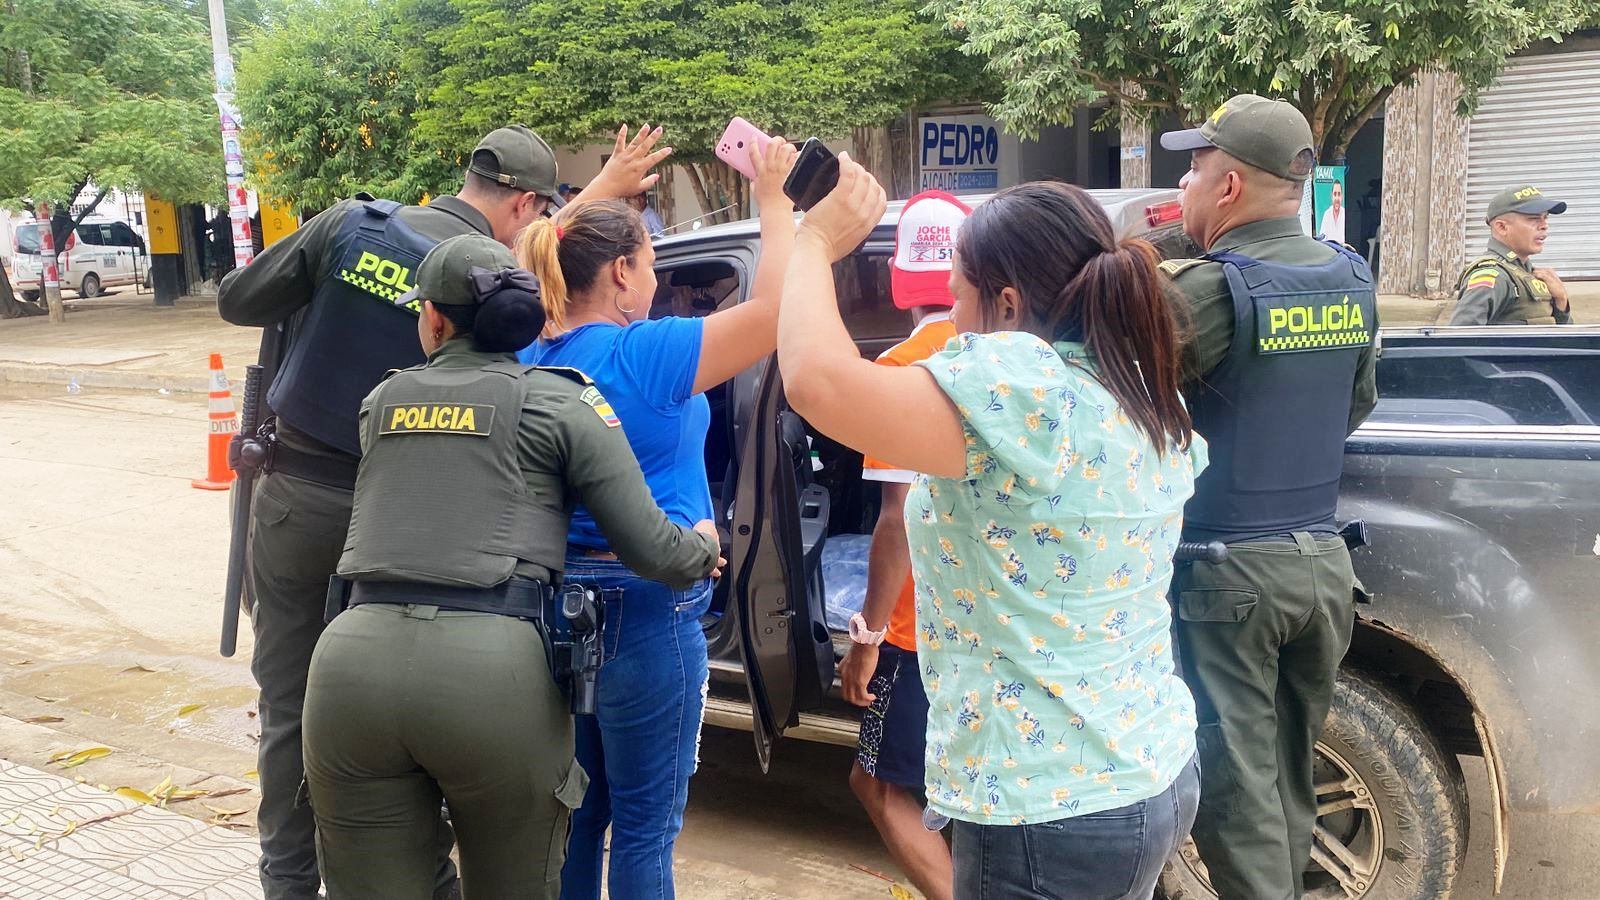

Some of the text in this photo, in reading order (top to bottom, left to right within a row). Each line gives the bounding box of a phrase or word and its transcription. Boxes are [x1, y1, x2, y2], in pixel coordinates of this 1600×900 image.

[922, 122, 998, 166] PEDRO
[922, 172, 958, 191] ALCALDE
[1513, 186, 1543, 200] POLI
[916, 226, 951, 234] JOCHE
[938, 248, 953, 260] 51
[355, 251, 413, 292] POL
[1269, 295, 1364, 334] POLICÍA
[390, 406, 476, 430] POLICIA
